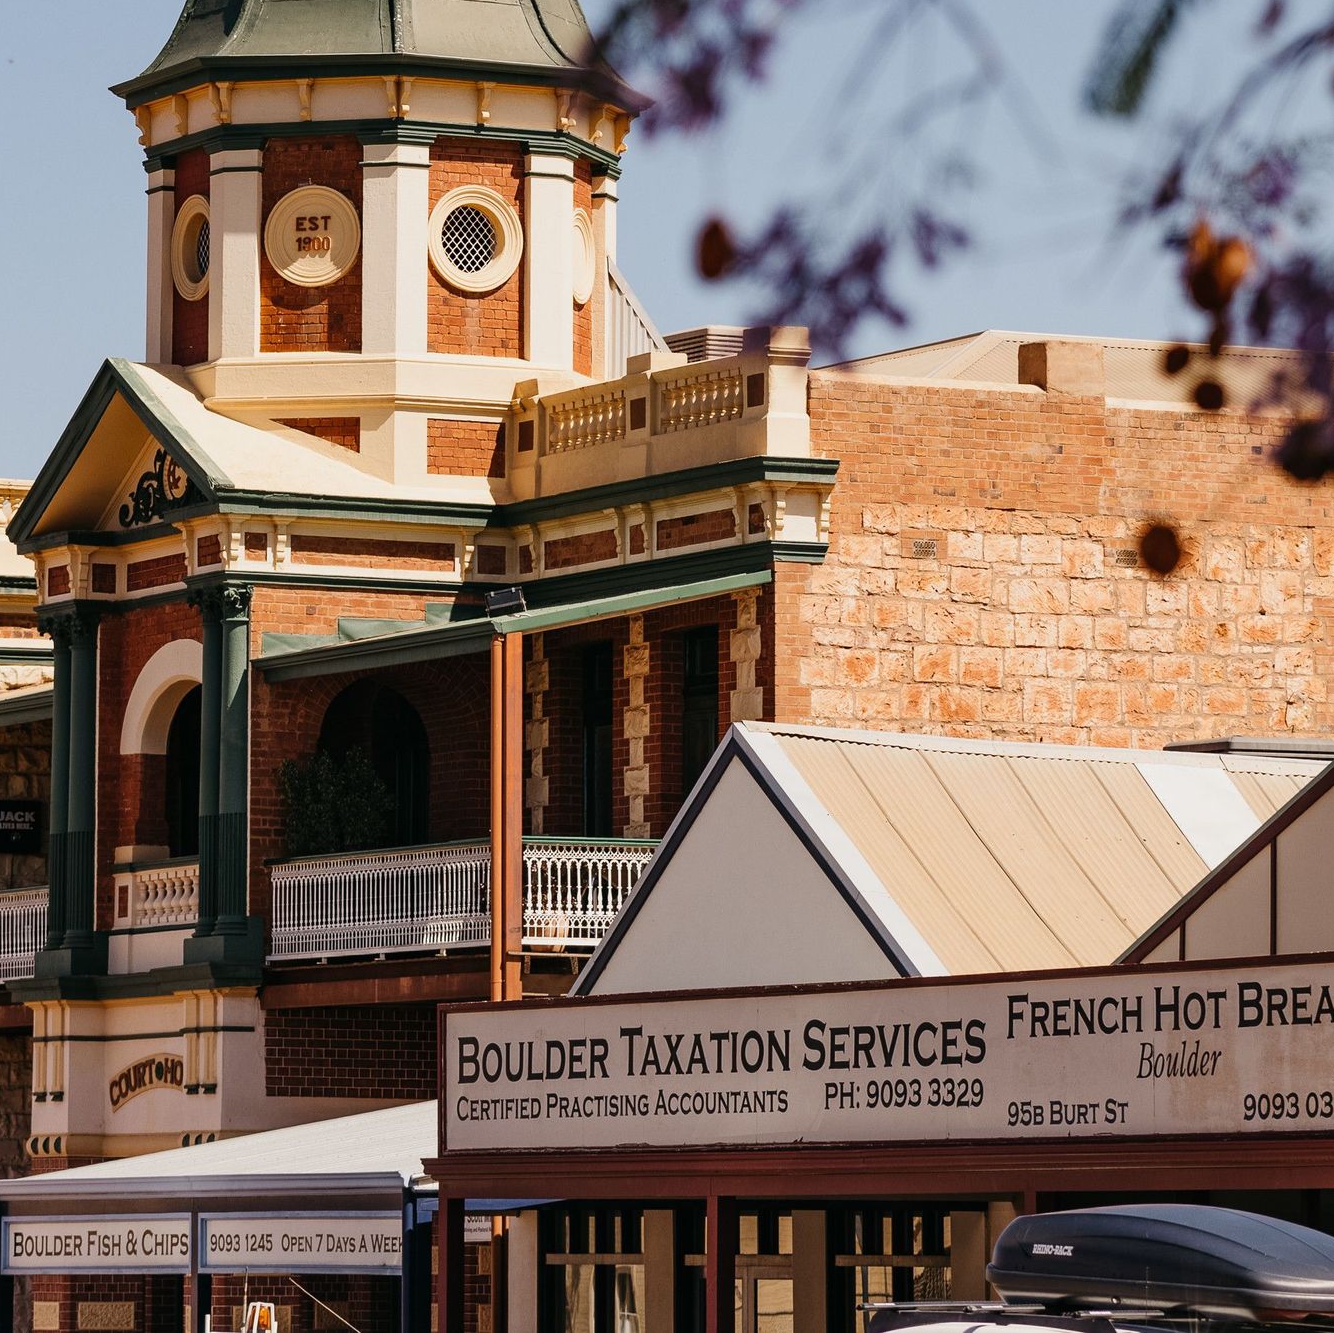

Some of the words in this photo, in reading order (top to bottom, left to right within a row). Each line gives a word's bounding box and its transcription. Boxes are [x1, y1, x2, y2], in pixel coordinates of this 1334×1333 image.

[295, 215, 332, 232] EST
[295, 235, 332, 252] 1900
[1007, 993, 1143, 1039] FRENCH
[1154, 986, 1227, 1032] HOT
[458, 1036, 610, 1084] BOULDER
[620, 1024, 791, 1076] TAXATION
[802, 1018, 986, 1071] SERVICES
[1136, 1040, 1222, 1079] Boulder
[109, 1058, 156, 1107] COURT
[457, 1096, 542, 1122] CERTIFIED
[546, 1092, 650, 1119] PRACTISING
[654, 1089, 789, 1116] ACCOUNTANTS
[824, 1081, 861, 1110] PH:
[866, 1078, 922, 1108] 9093
[927, 1078, 985, 1108] 3329
[1007, 1100, 1044, 1127] 95B
[1049, 1099, 1100, 1126] BURT
[1104, 1097, 1129, 1123] ST
[1243, 1093, 1300, 1121] 9093
[13, 1232, 83, 1257] BOULDER
[87, 1230, 122, 1257] FISH
[125, 1229, 138, 1256] &
[141, 1229, 189, 1256] CHIPS
[210, 1234, 241, 1252] 9093
[244, 1233, 273, 1252] 1245
[281, 1233, 313, 1252] OPEN
[315, 1234, 324, 1252] 7
[326, 1234, 356, 1253] DAYS
[358, 1234, 368, 1253] A
[1032, 1243, 1074, 1256] RHINO-RACK
